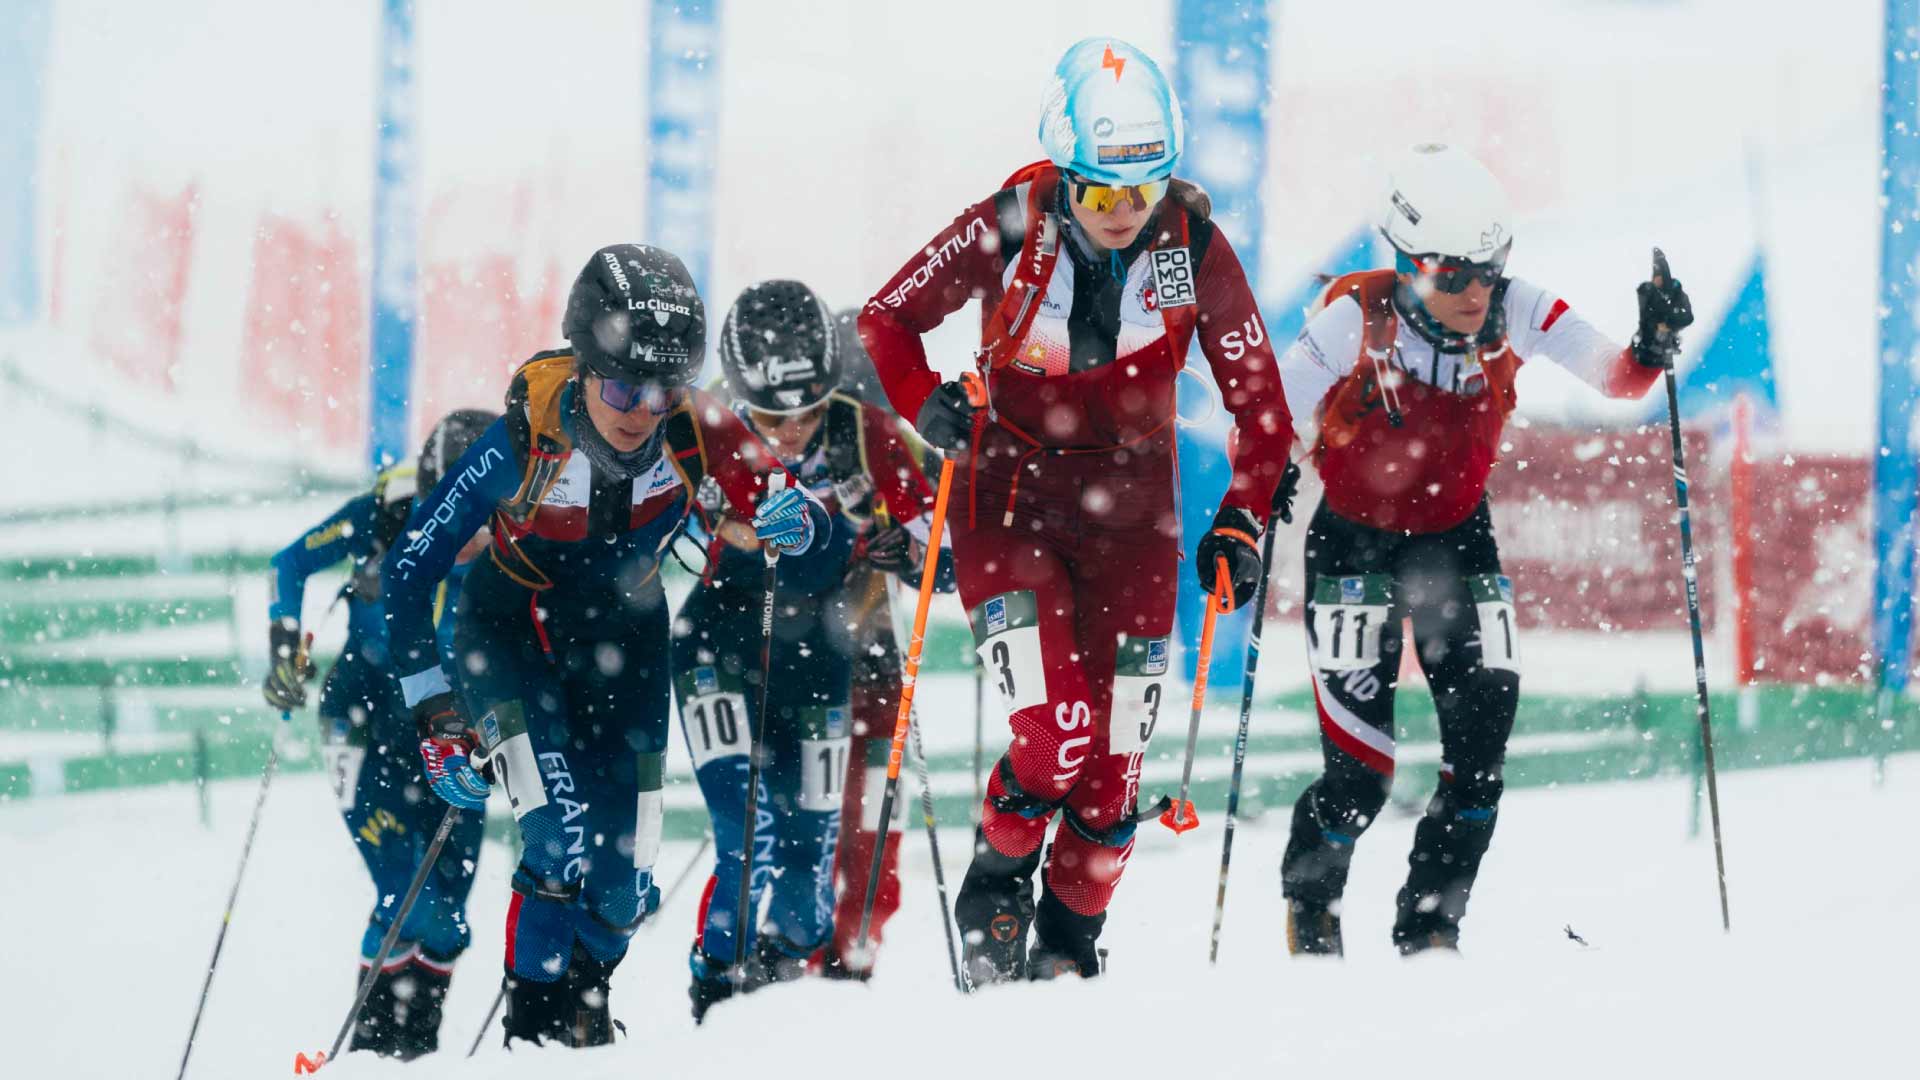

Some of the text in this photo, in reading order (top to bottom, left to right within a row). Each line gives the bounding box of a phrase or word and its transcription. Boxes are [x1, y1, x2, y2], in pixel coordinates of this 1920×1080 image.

[603, 252, 631, 291] ATOMIC
[883, 217, 989, 307] SPORTIVA
[1155, 251, 1186, 268] PO
[1158, 267, 1188, 284] MO
[628, 298, 690, 316] La Clusaz
[1161, 283, 1192, 300] CA
[411, 447, 504, 556] SPORTIVA
[763, 590, 774, 637] ATOMIC
[1331, 609, 1368, 658] 11
[992, 641, 1016, 700] 3
[693, 698, 739, 750] 10
[1139, 682, 1162, 742] 3
[1235, 711, 1249, 764] VERTICAL
